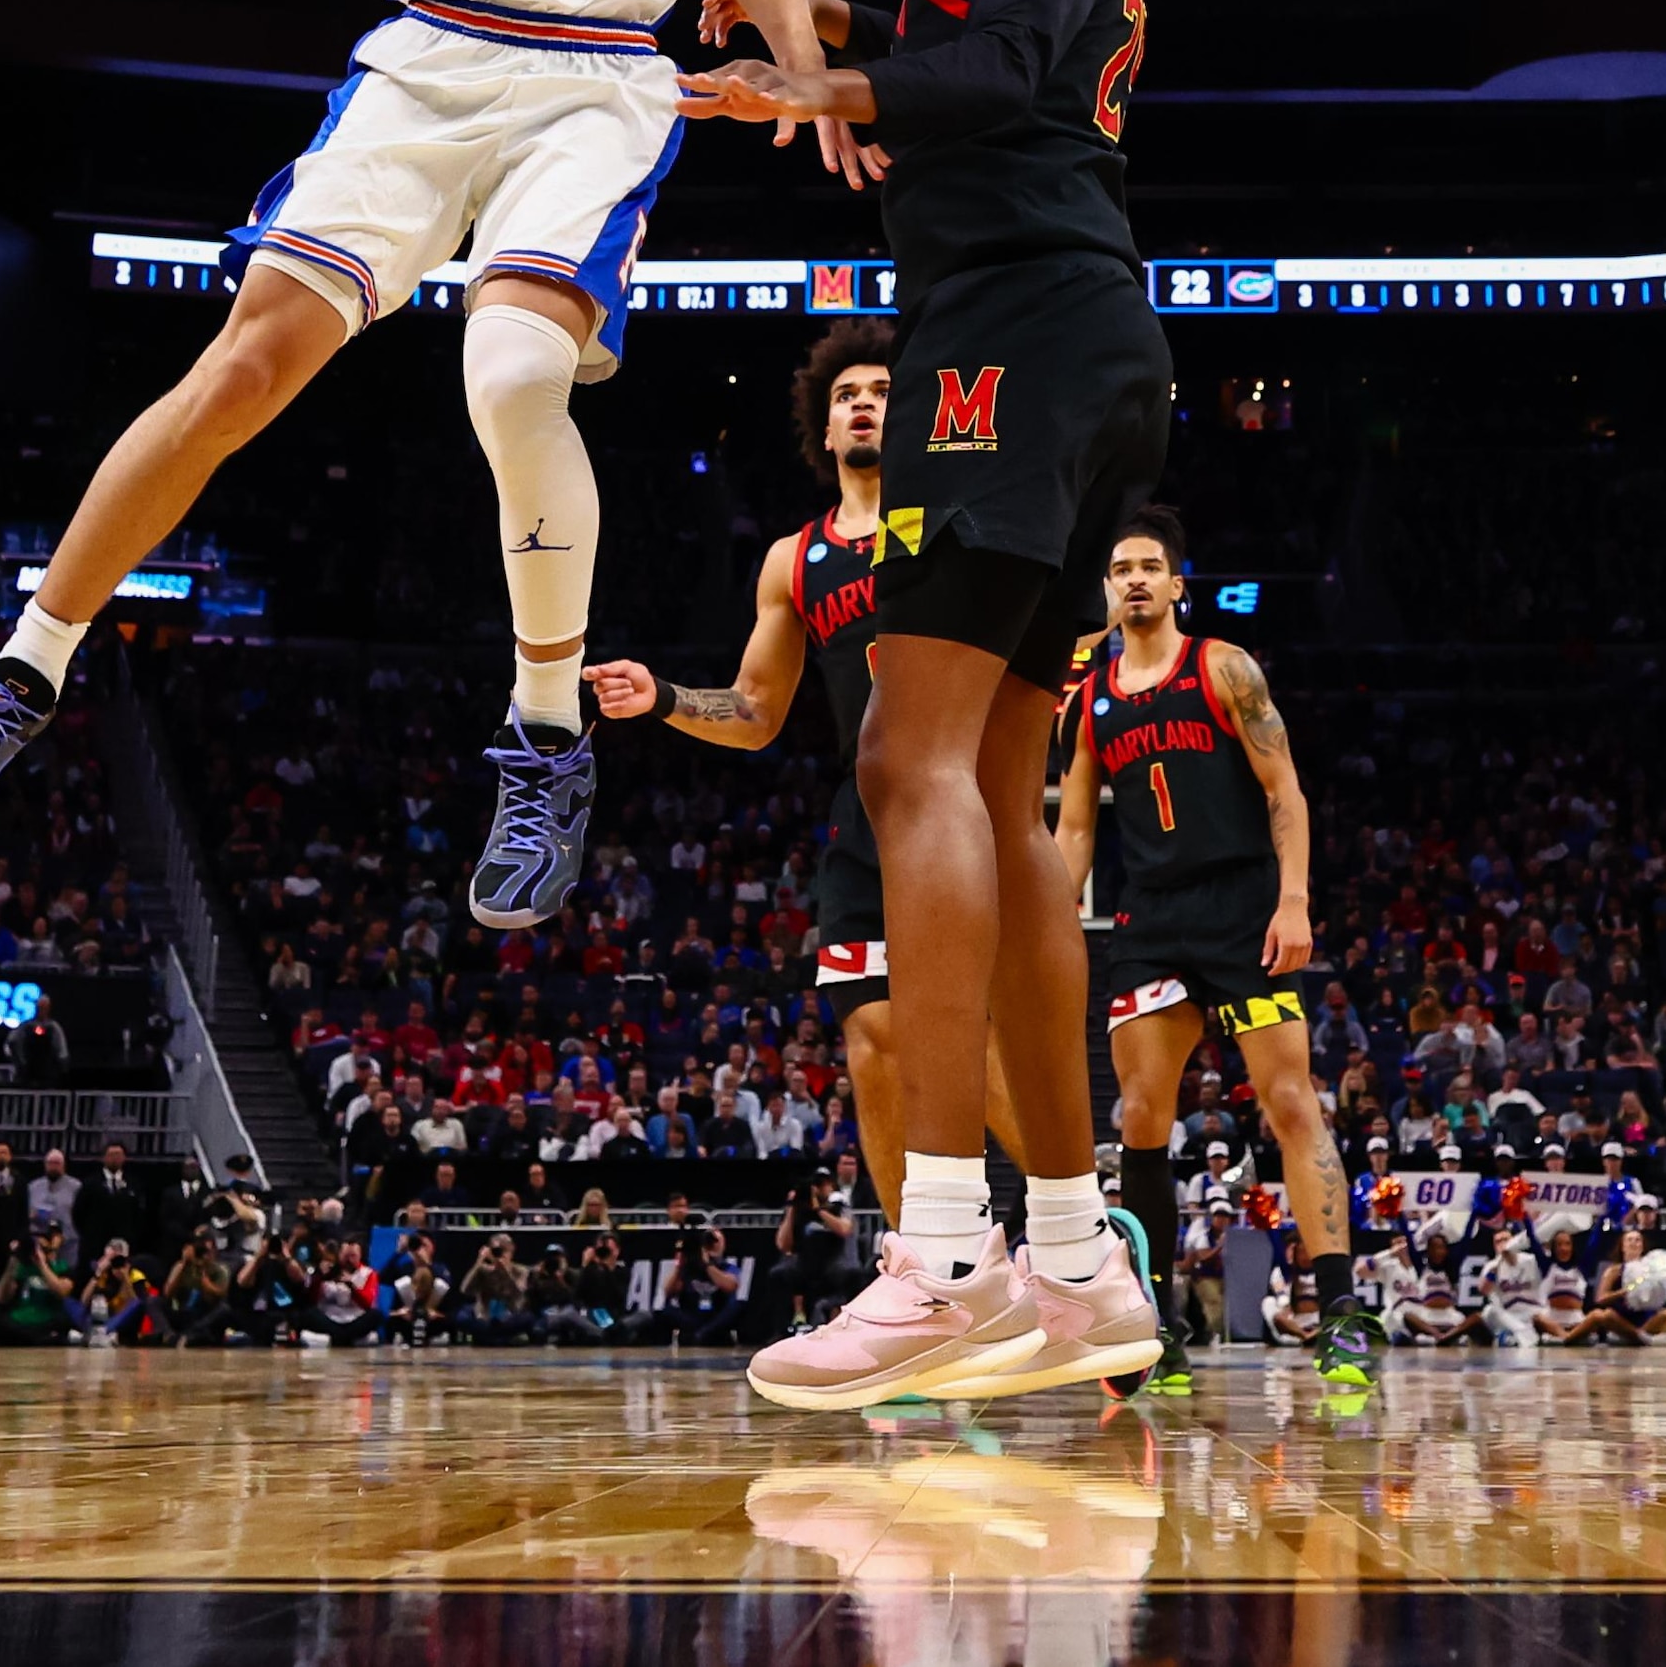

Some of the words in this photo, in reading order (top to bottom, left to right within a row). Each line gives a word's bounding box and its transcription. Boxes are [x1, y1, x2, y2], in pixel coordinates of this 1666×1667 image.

[876, 270, 896, 306] 1
[1170, 269, 1211, 304] 22
[1560, 283, 1574, 307] 7
[1611, 282, 1626, 307] 7
[929, 366, 1005, 441] M
[807, 575, 876, 646] MARY
[1100, 720, 1216, 777] MARYLAND
[1150, 761, 1176, 832] 1
[1416, 1178, 1457, 1205] GO
